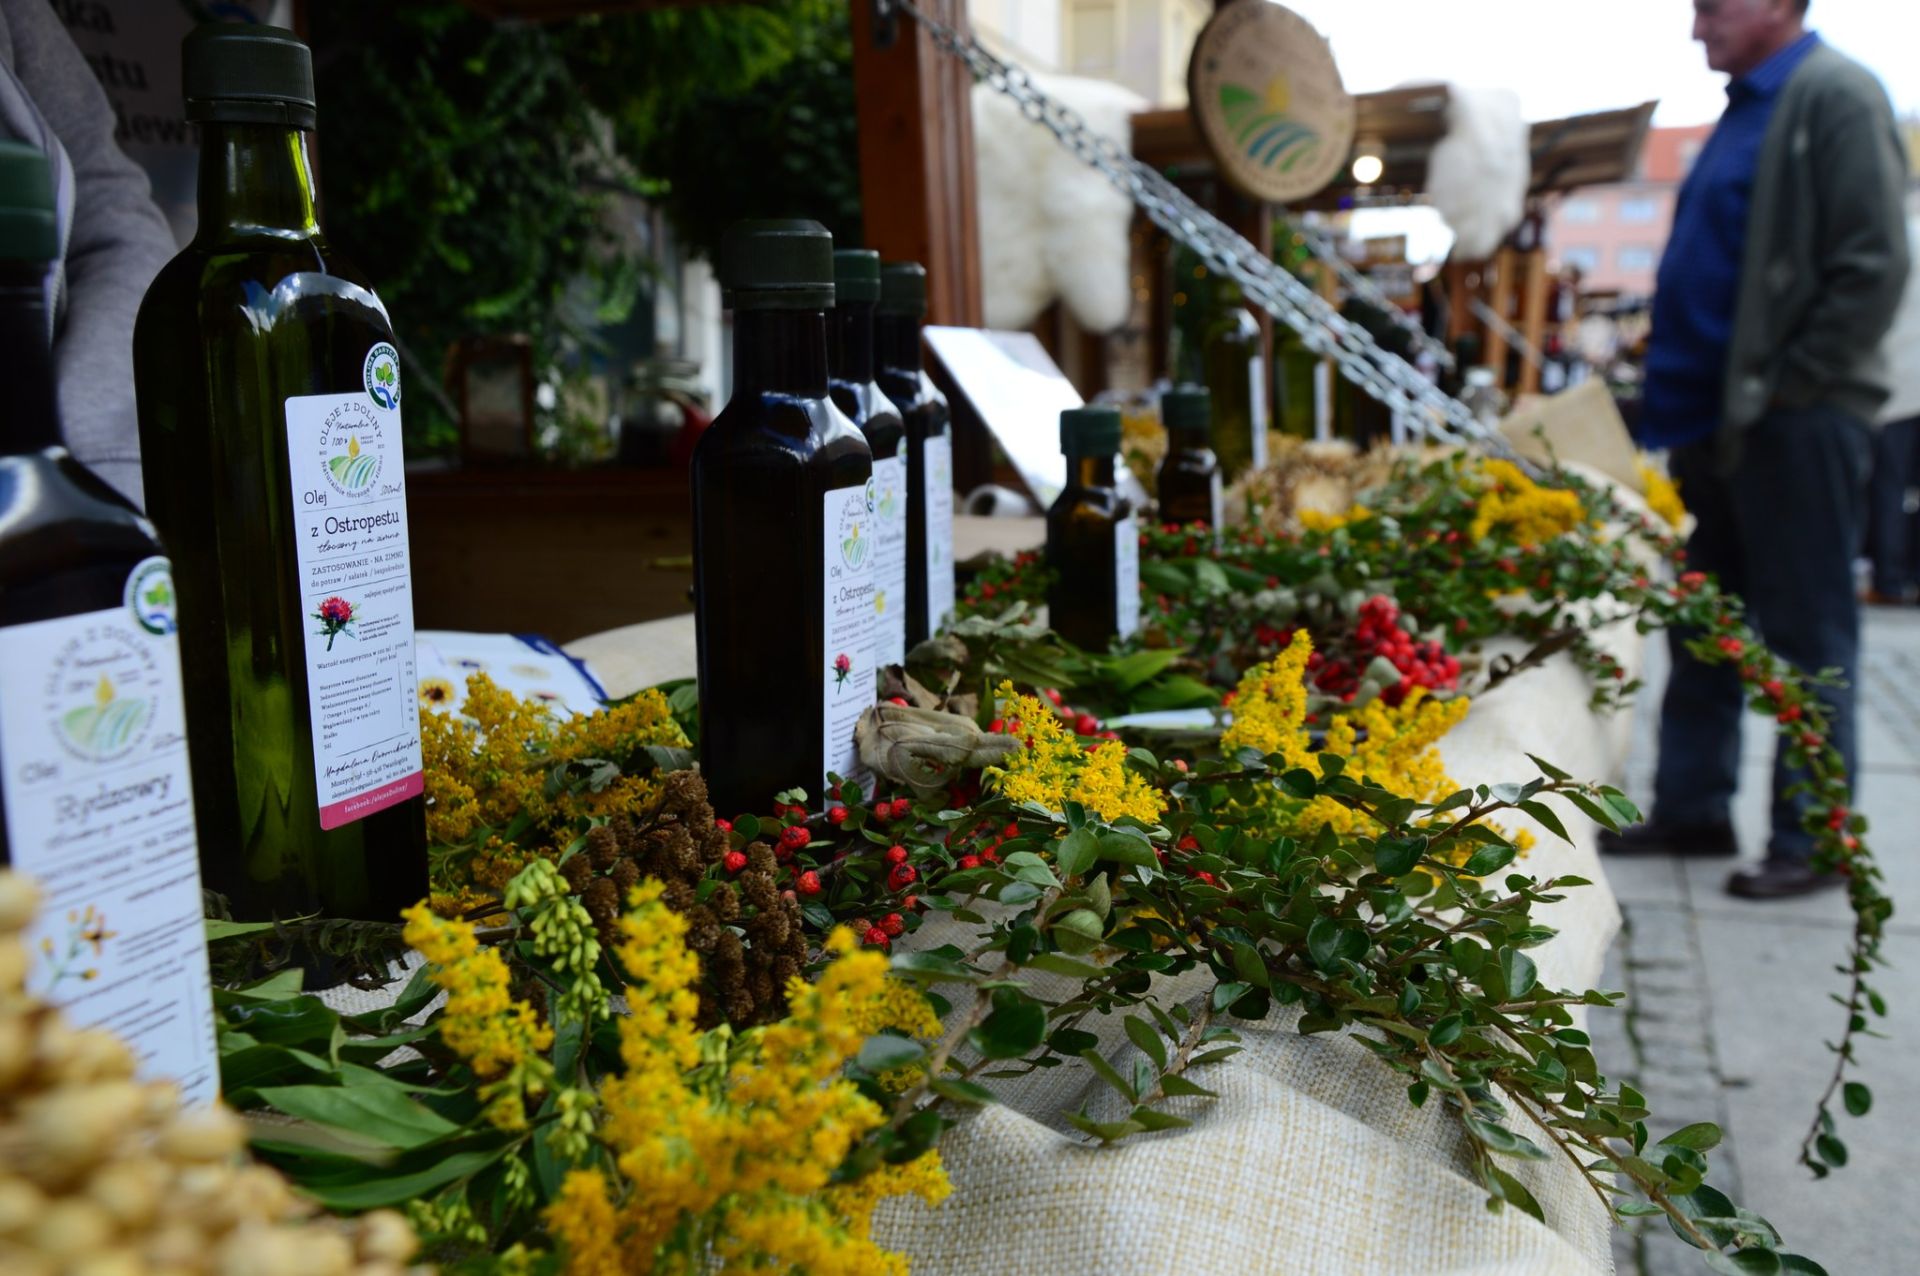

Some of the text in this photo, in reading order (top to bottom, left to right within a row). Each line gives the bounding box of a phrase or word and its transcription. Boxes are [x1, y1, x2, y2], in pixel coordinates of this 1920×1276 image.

[320, 402, 382, 446] OLEJE Z DOLINY
[304, 490, 327, 506] Olej
[311, 510, 400, 538] z Ostropestu
[312, 557, 369, 576] ZASTOSOWANIE
[374, 553, 384, 564] NA
[385, 550, 404, 562] ZIMNO
